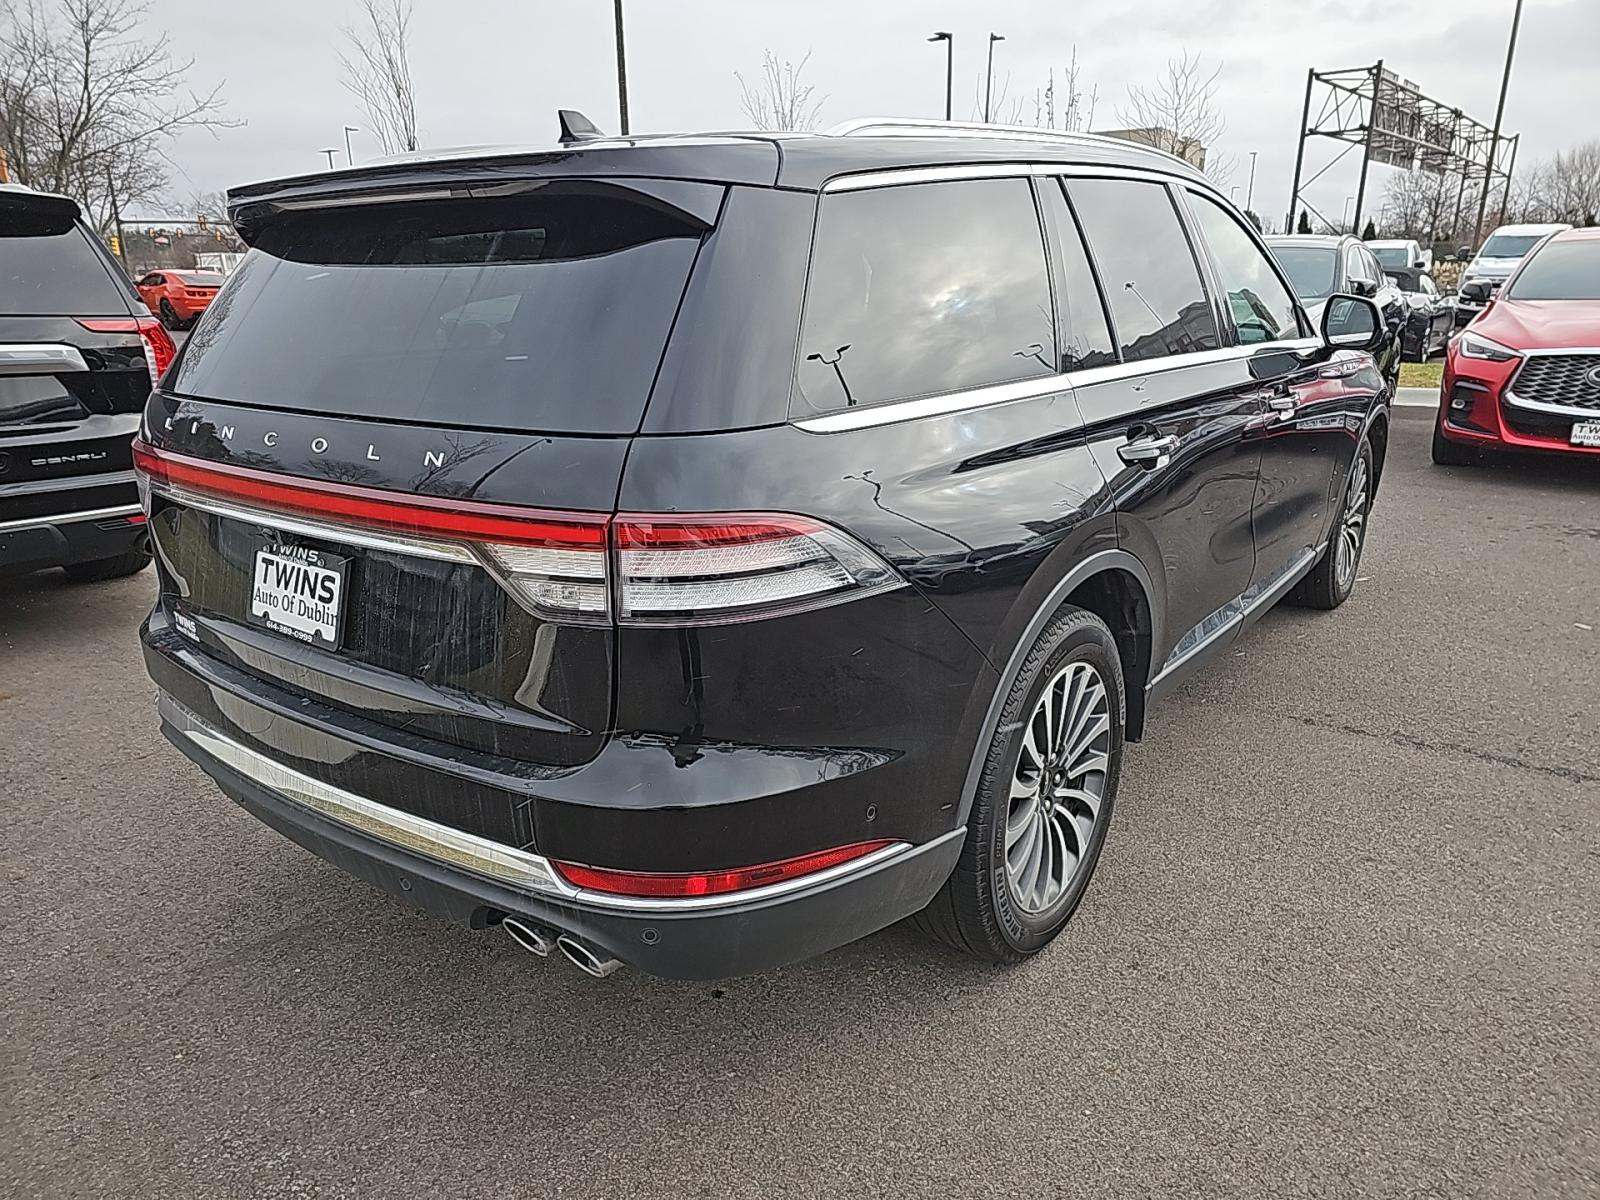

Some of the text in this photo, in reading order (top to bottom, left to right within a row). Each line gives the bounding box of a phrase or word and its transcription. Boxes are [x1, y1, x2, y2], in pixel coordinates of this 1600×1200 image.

[31, 451, 107, 466] DENALI
[164, 417, 445, 468] LINCOLN
[254, 586, 279, 609] Auto
[281, 594, 296, 614] Of
[261, 557, 336, 605] TWINS
[996, 871, 1022, 937] MICHELIN
